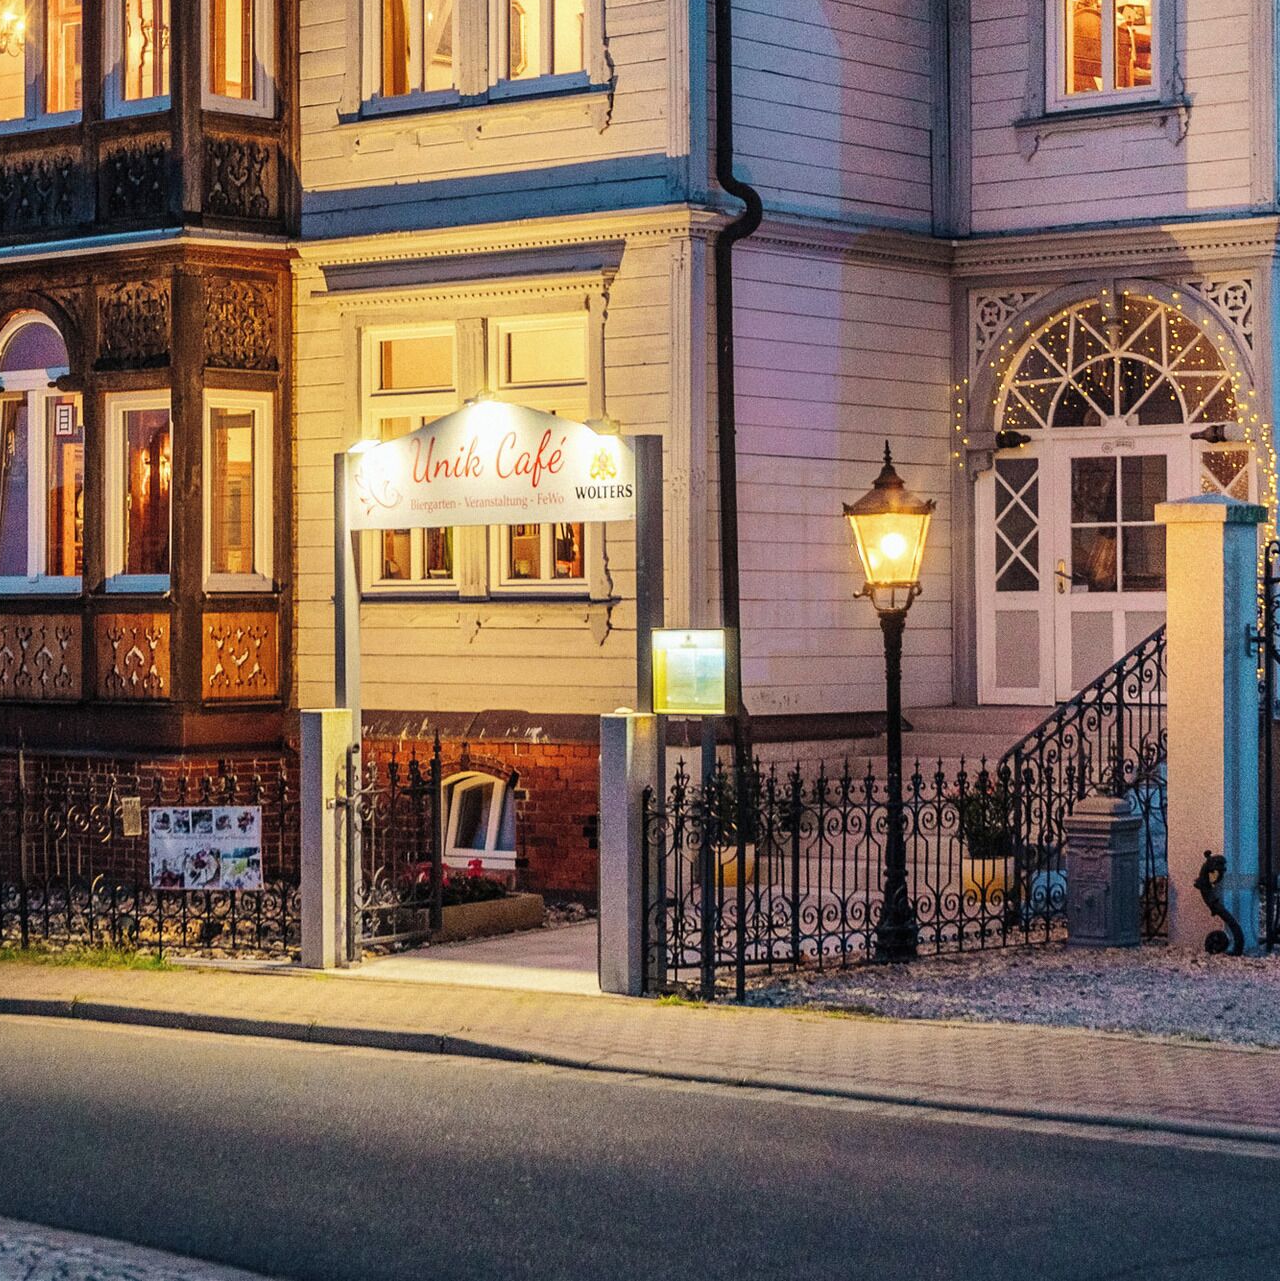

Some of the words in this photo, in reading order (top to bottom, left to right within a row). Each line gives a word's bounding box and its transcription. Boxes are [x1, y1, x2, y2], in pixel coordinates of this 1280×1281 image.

[411, 434, 484, 483] Unik
[496, 428, 567, 488] Café
[411, 498, 457, 513] Biergarten
[464, 495, 529, 510] Veranstaltung
[537, 491, 565, 505] FeWo
[575, 484, 633, 500] WOLTERS
